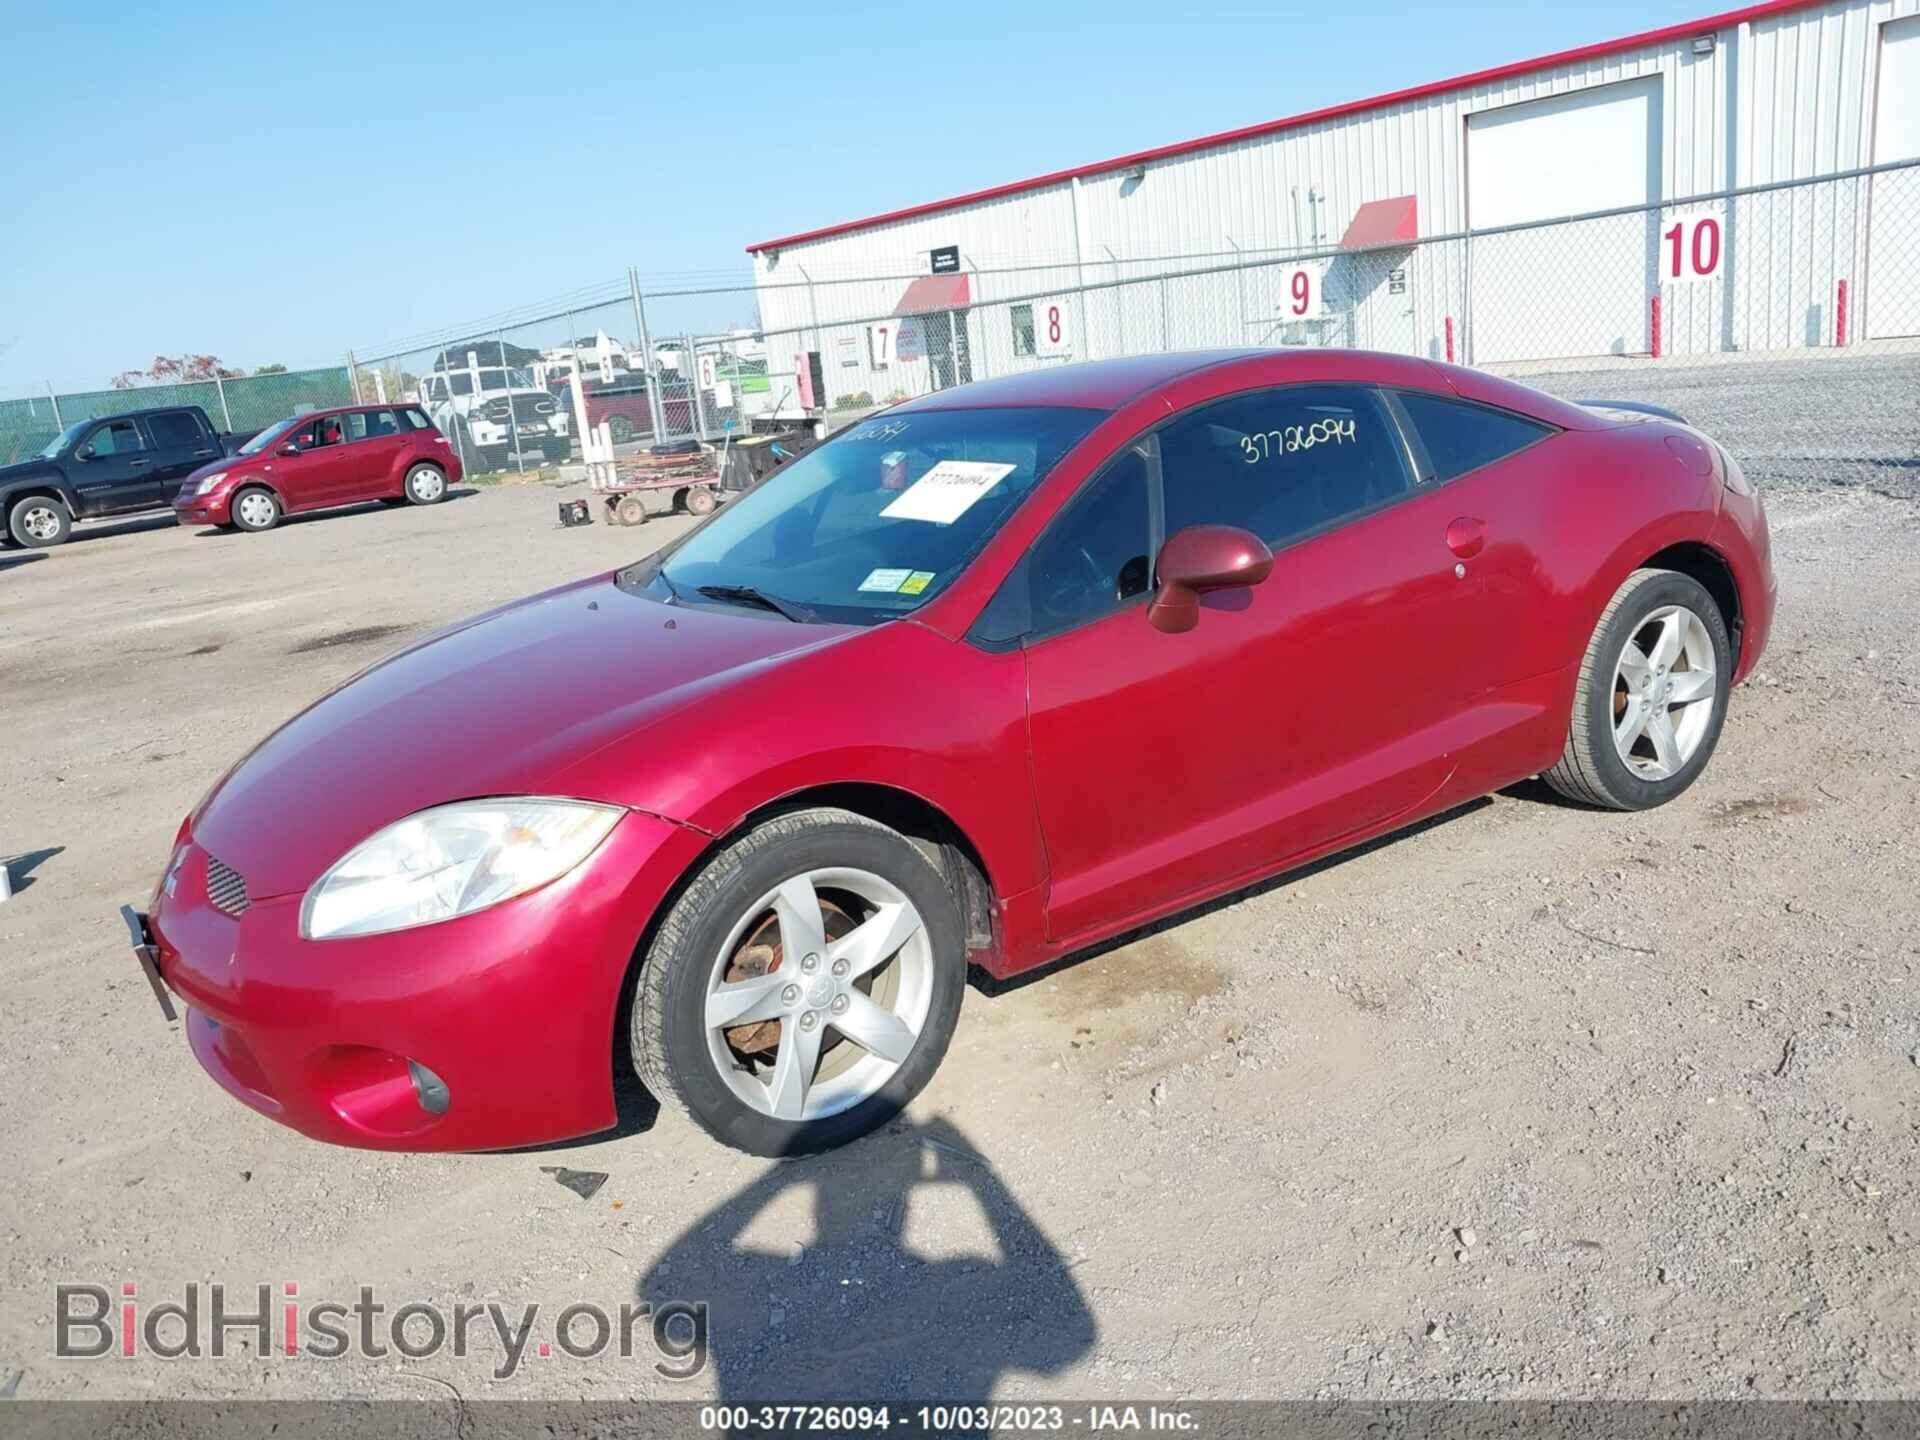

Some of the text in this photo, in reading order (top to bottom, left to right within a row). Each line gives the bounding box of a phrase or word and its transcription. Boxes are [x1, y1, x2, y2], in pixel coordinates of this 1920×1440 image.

[1665, 219, 1719, 277] 10
[1291, 271, 1309, 315] 9
[878, 327, 888, 359] 7
[1048, 306, 1061, 343] 8
[703, 359, 712, 386] 6
[1241, 418, 1356, 464] 37726094
